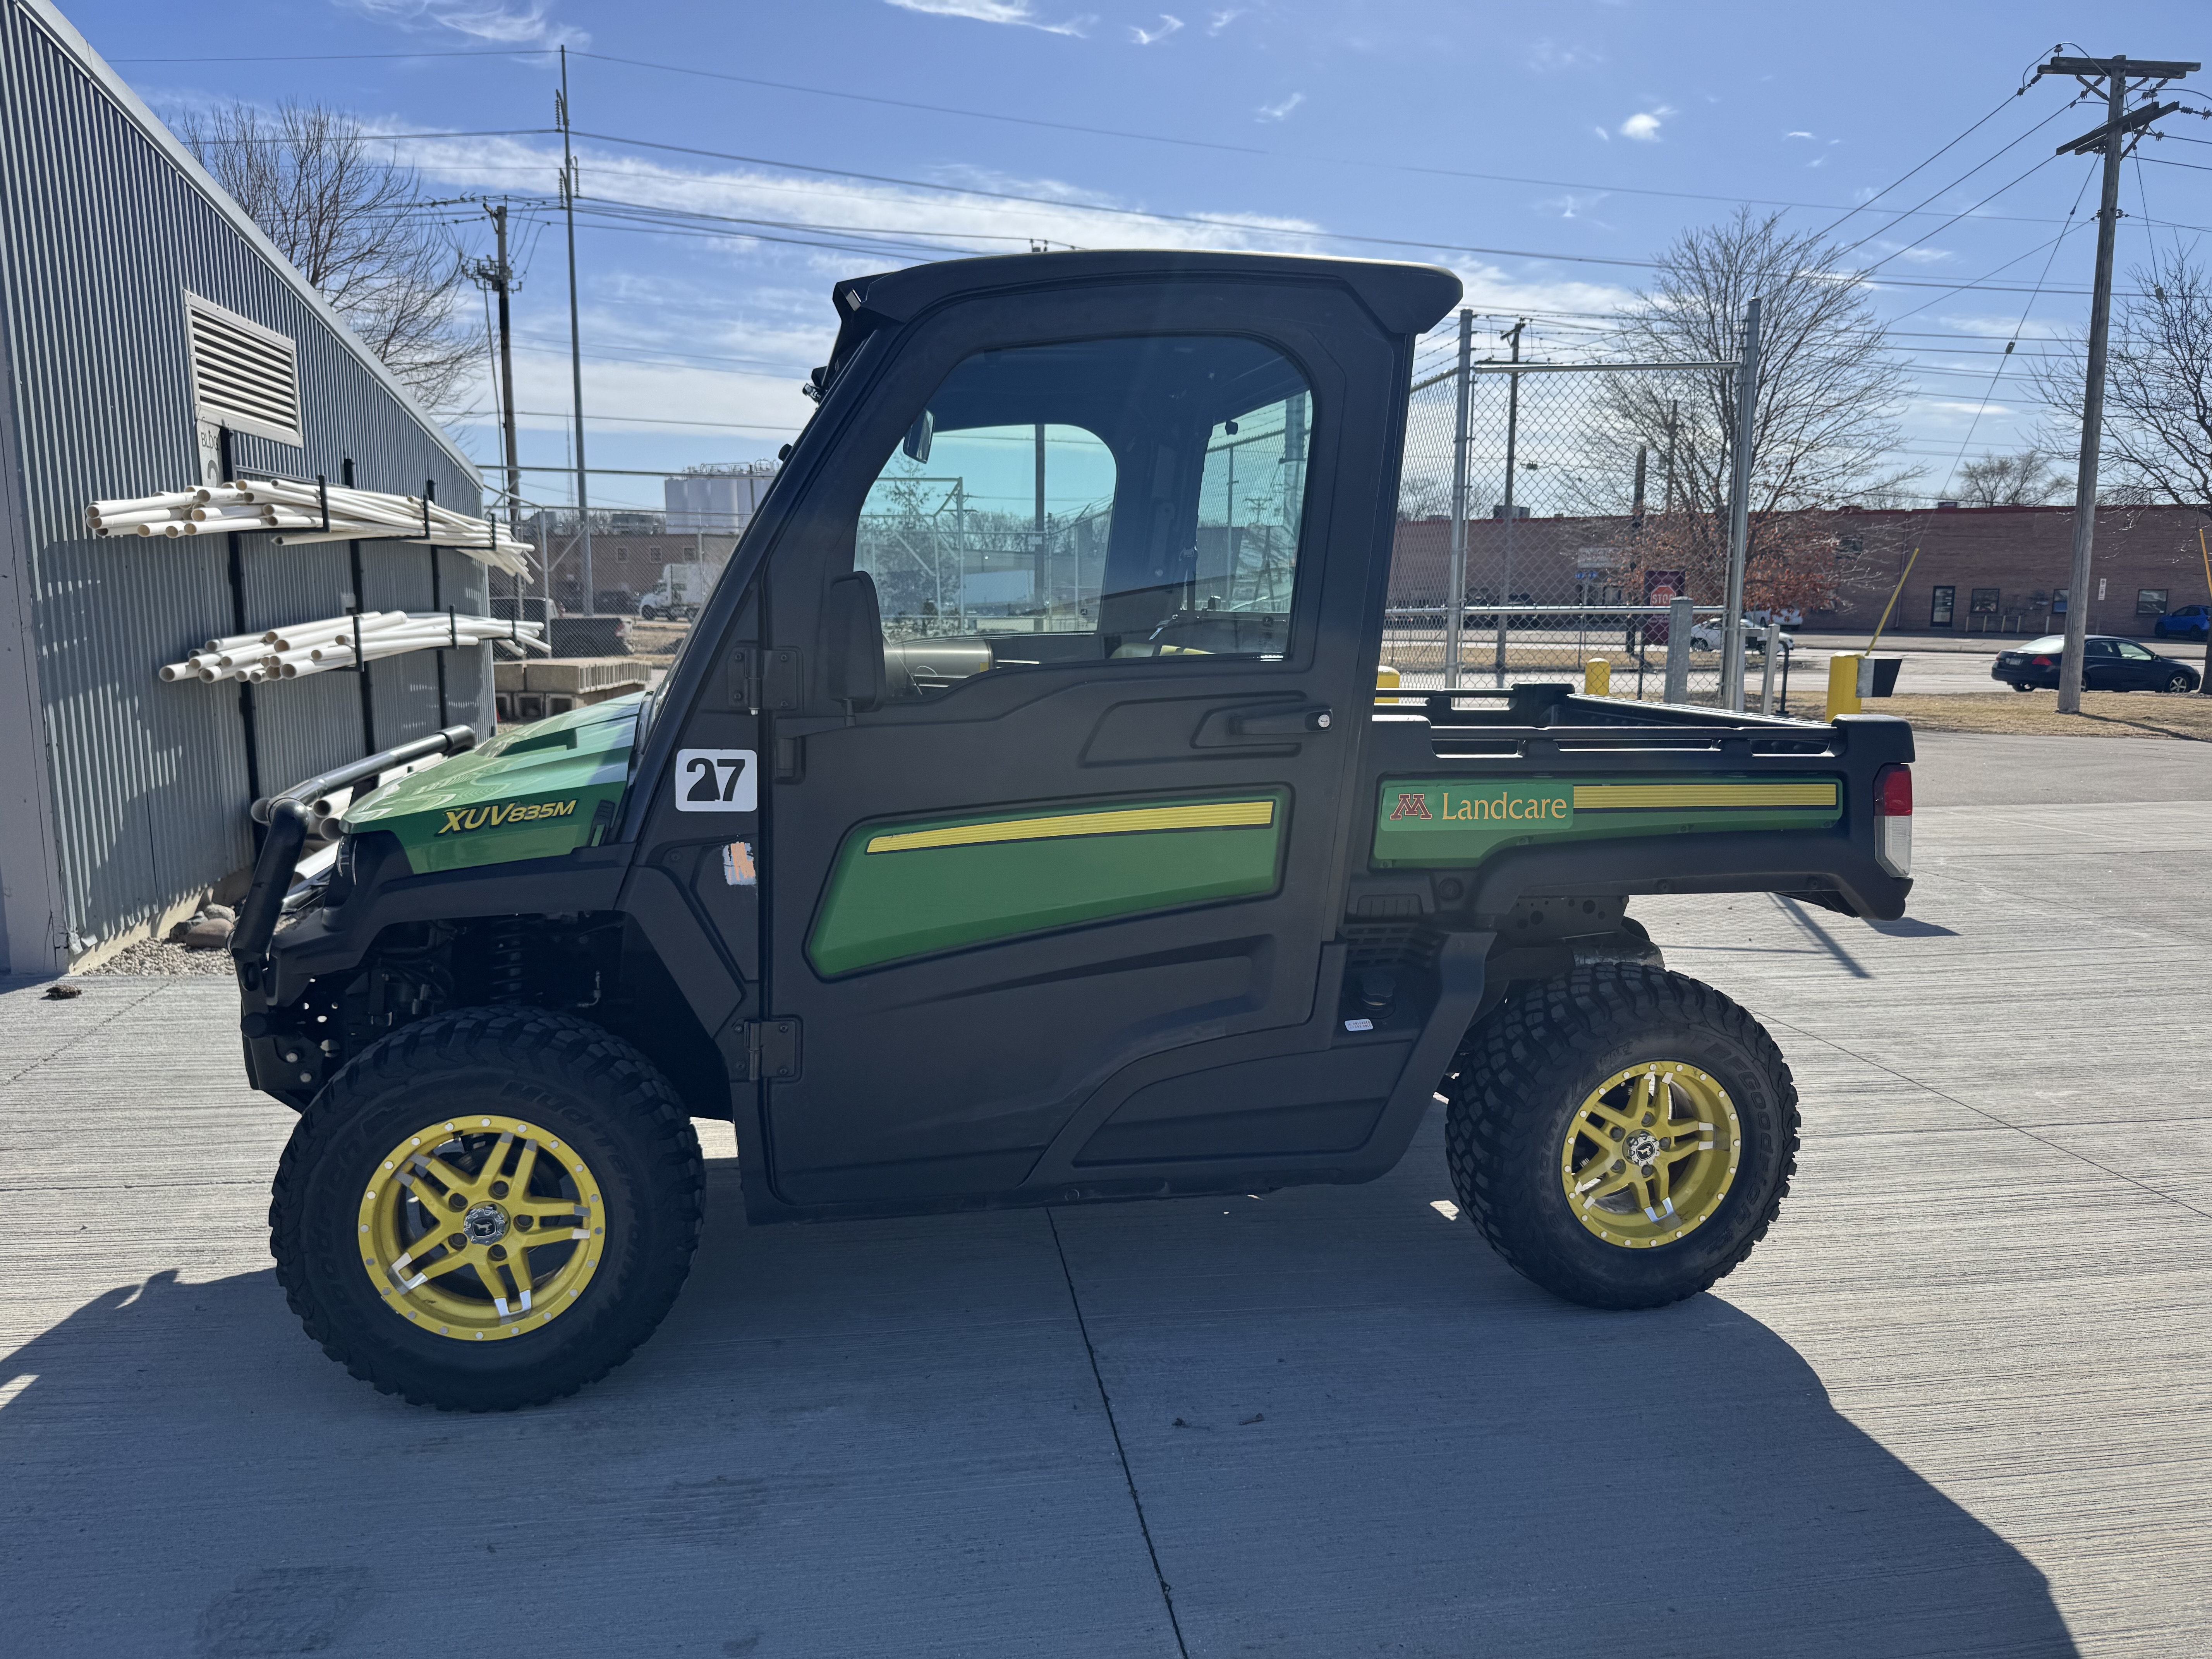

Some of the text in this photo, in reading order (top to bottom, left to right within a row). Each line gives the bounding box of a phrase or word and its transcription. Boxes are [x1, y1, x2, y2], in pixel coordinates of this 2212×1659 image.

[1652, 593, 1674, 604] STOP
[686, 757, 745, 802] 27
[437, 799, 577, 834] XUV835M
[1442, 792, 1568, 819] Landcare
[1705, 1042, 1774, 1225] BFGoodrich
